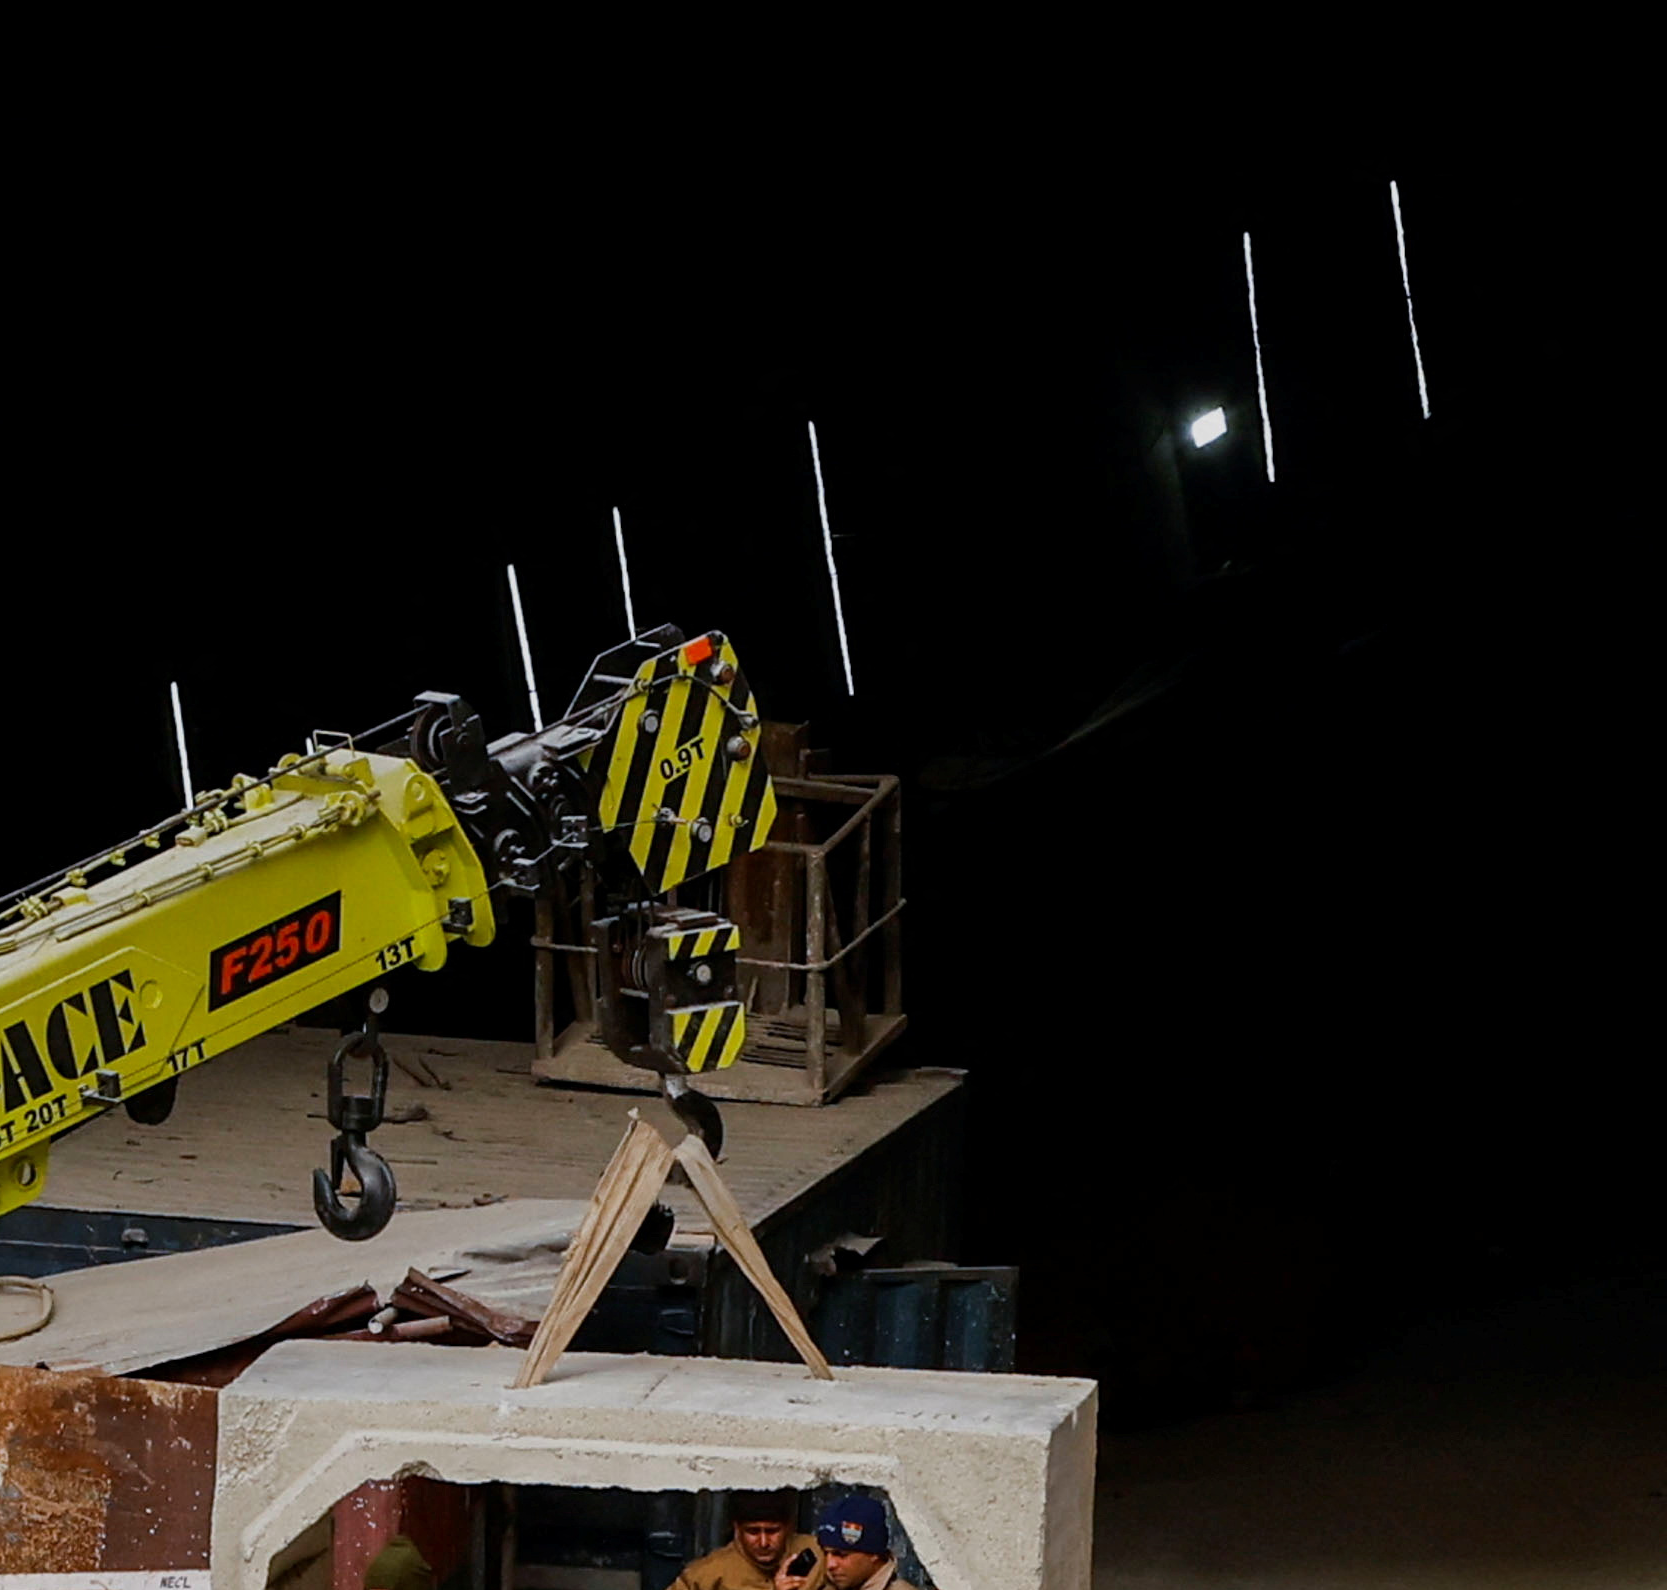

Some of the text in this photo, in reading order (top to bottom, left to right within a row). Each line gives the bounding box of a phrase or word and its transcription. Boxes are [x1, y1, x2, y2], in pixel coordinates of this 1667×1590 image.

[660, 737, 706, 781] 0.9T
[219, 910, 331, 996] F250
[375, 935, 417, 972] 13T
[167, 1039, 208, 1073] 17T
[27, 1097, 68, 1134] 20T
[160, 1576, 192, 1589] NECL
